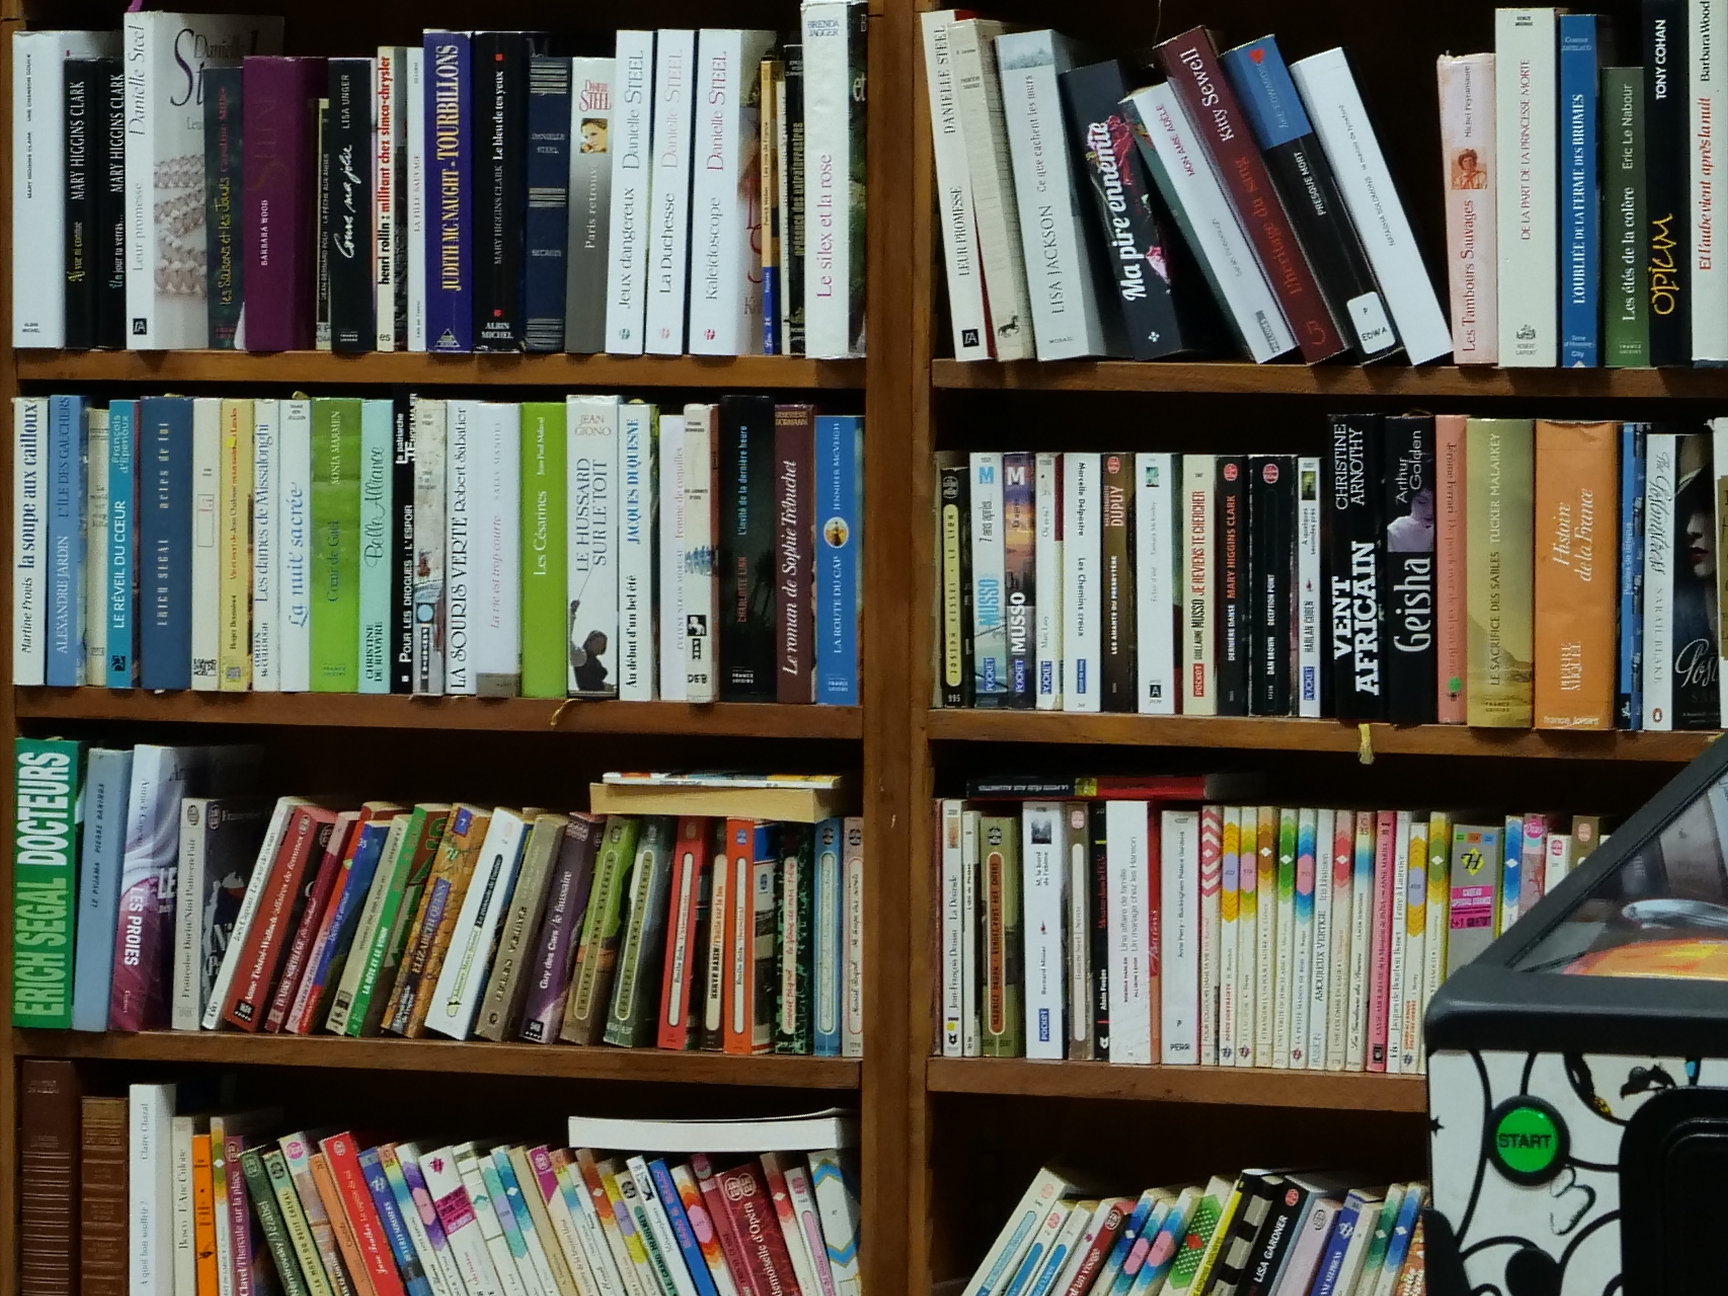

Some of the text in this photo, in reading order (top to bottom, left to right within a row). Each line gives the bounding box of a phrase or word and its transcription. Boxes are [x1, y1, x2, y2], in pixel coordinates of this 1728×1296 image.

[1179, 46, 1236, 143] Kitty Sewell
[1655, 19, 1667, 100] TONY COHAN
[70, 81, 85, 200] MARY HIGGINS CLARK
[1038, 204, 1065, 314] LISA JACKSON
[1088, 121, 1148, 301] Ma pire ennemie
[1648, 213, 1680, 315] OPIUM
[575, 458, 591, 572] LE HUSSARD
[592, 459, 608, 566] SUR LE TOIT
[1333, 424, 1348, 510] CHRISTINE
[1348, 427, 1365, 507] ARNOTHY
[449, 516, 468, 689] LA SOURIS VERTE
[1010, 592, 1026, 652] MUSSO
[1331, 575, 1353, 659] VENT
[1352, 540, 1380, 695] AFRICAIN
[1392, 557, 1432, 652] Geisha
[16, 751, 70, 866] DOCTEURS
[15, 877, 70, 947] SEGAL
[14, 950, 66, 1016] ERICH
[1497, 1130, 1552, 1151] START
[1253, 1214, 1288, 1283] LISA GARDNER
